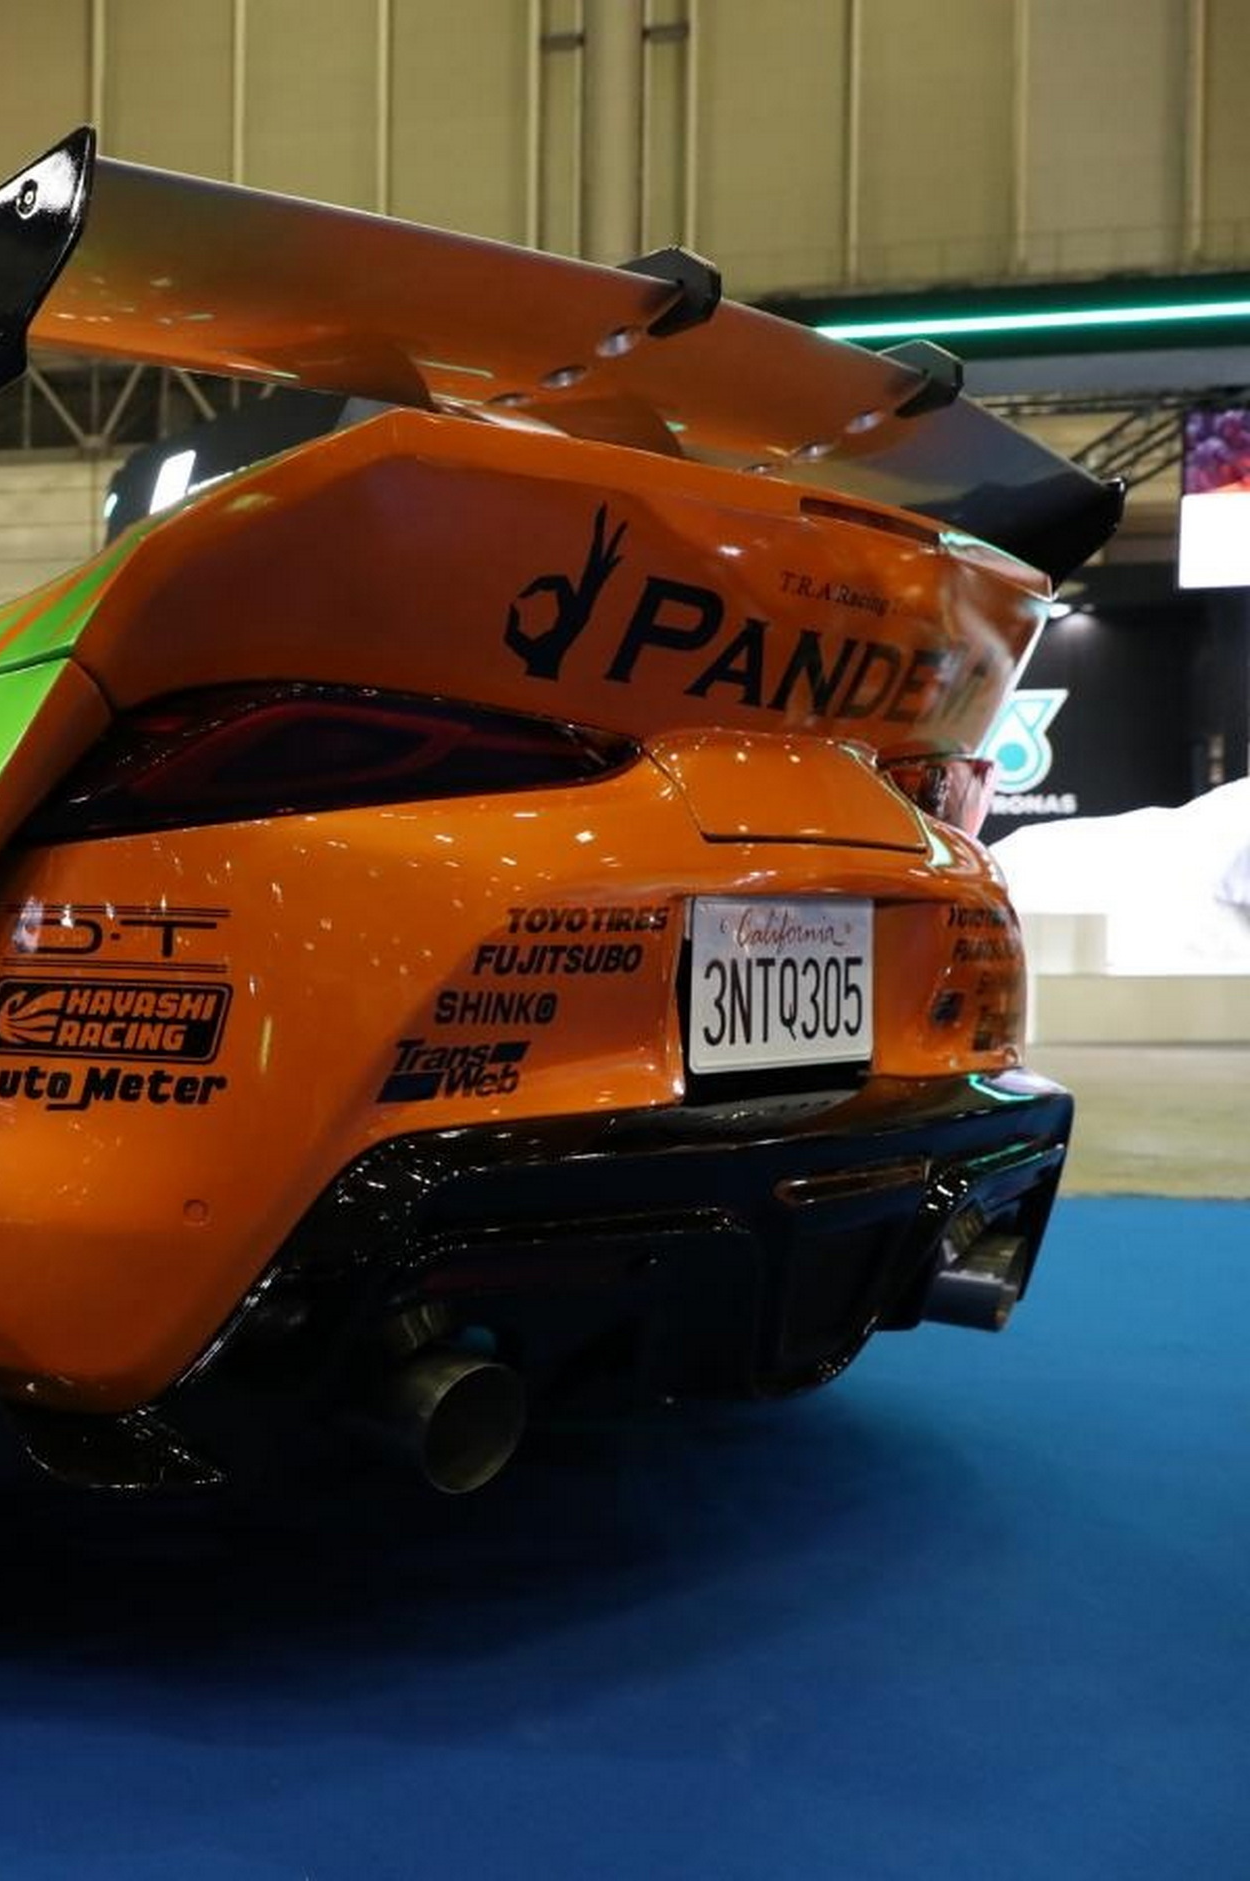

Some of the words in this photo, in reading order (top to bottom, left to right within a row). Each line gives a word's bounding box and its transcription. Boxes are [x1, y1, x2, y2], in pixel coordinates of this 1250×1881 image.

[507, 907, 589, 933] TOYO
[592, 906, 670, 932] TIRES
[736, 907, 846, 955] California
[472, 944, 643, 976] FUJITSUBO
[65, 988, 218, 1021] HAYASHI
[434, 991, 558, 1025] SHINKO
[703, 956, 863, 1047] 3NTQ305
[56, 1020, 188, 1050] RACING
[394, 1040, 493, 1073] Trans
[444, 1064, 522, 1098] Web
